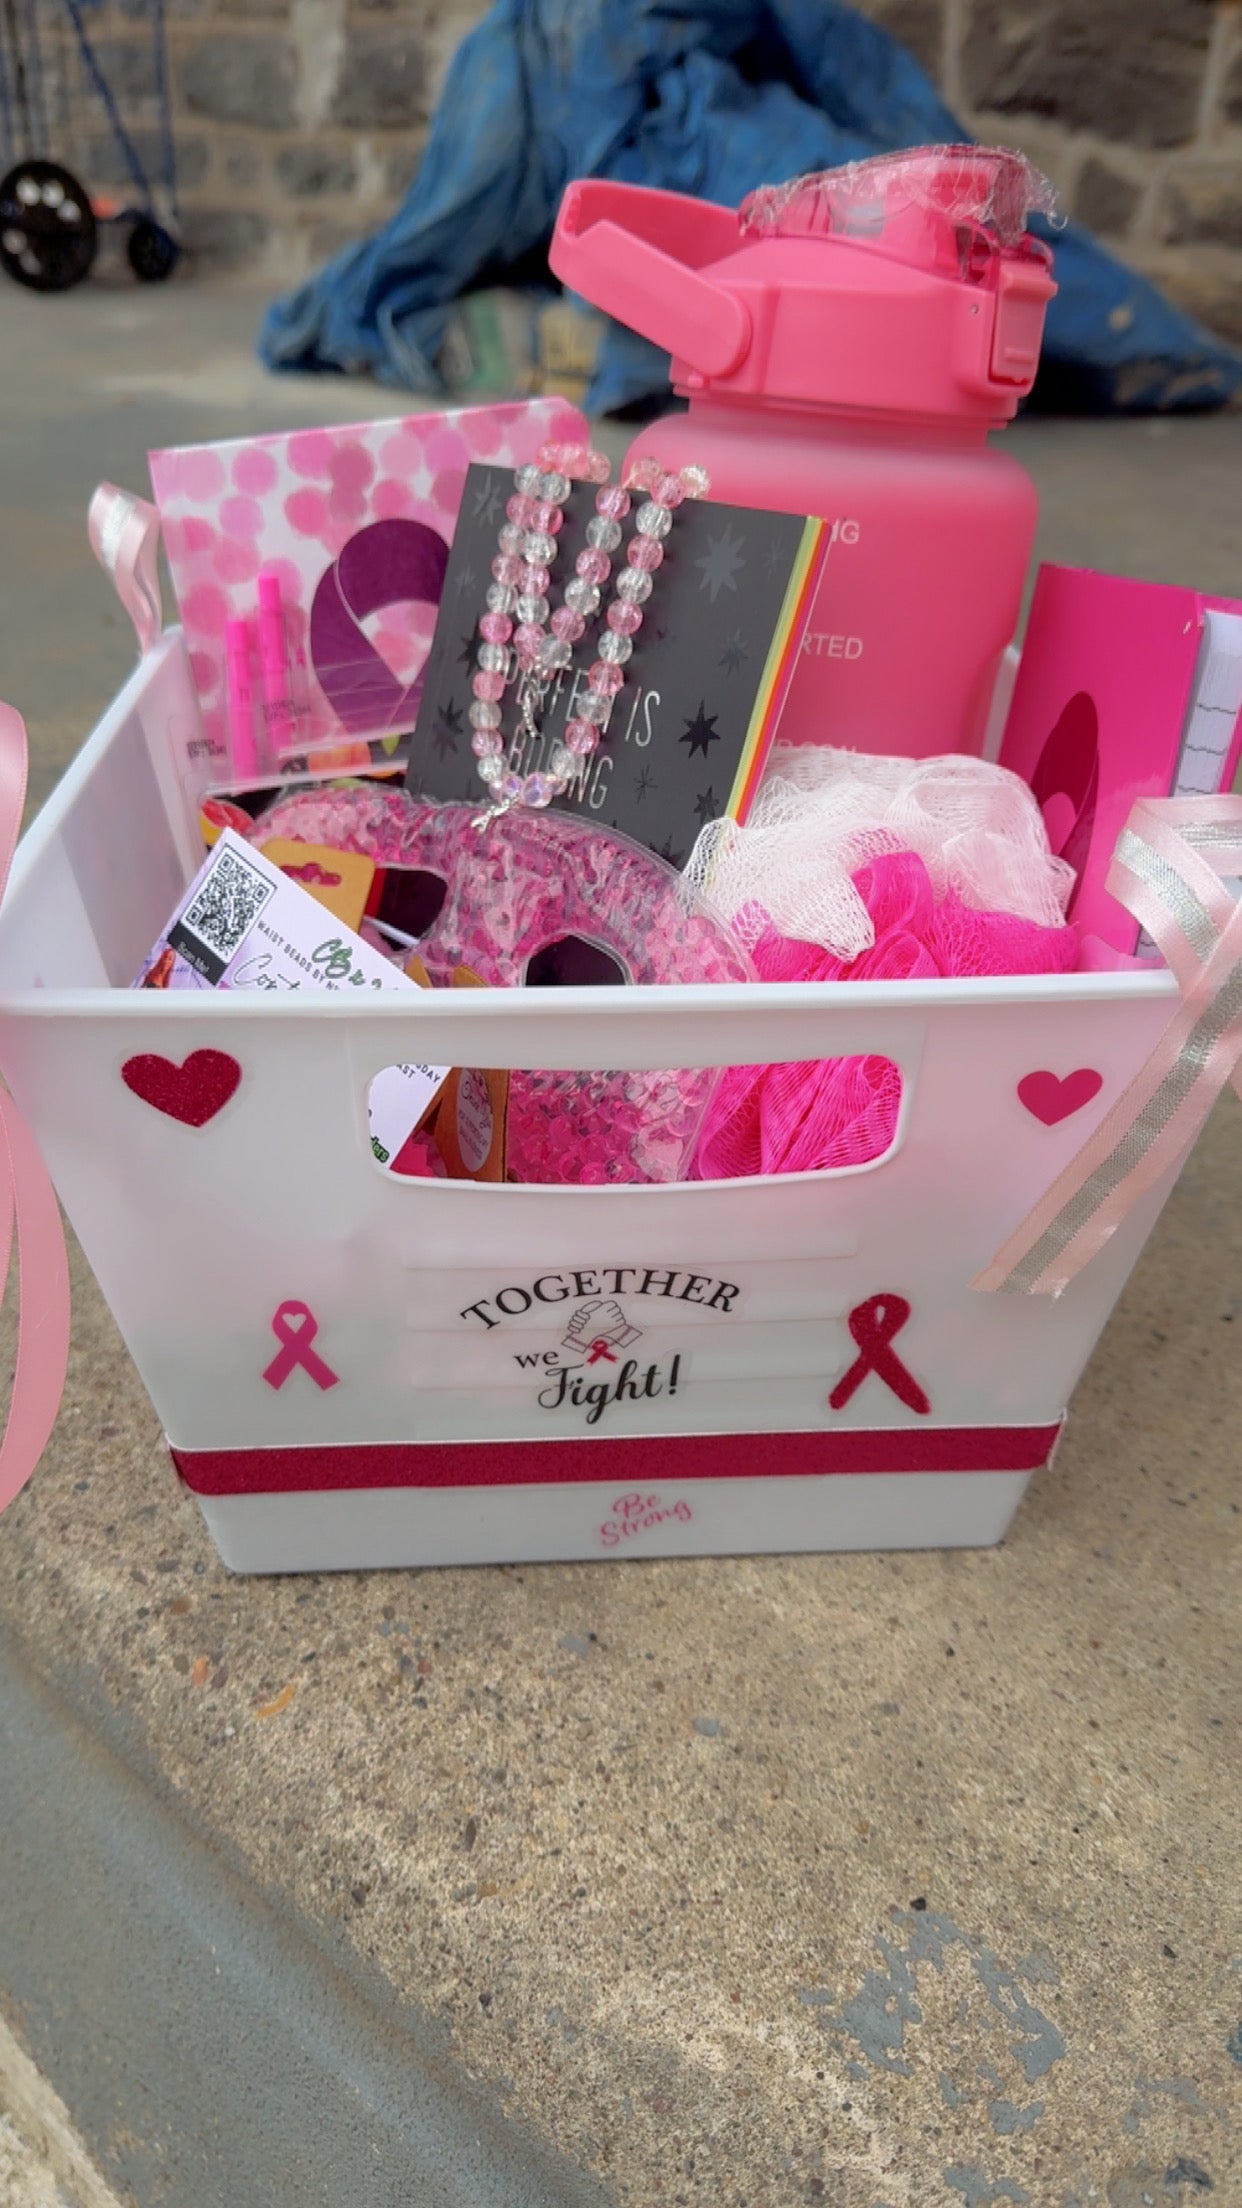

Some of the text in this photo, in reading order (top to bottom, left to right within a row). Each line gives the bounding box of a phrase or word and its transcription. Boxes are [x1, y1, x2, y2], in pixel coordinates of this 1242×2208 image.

[625, 686, 661, 747] IS
[257, 920, 285, 948] WAIST
[283, 943, 313, 973] BEADS
[460, 1268, 741, 1330] TOGETHER
[513, 1350, 560, 1369] we
[537, 1353, 682, 1425] Fight!
[600, 1500, 692, 1547] Strong
[612, 1492, 660, 1519] Be
